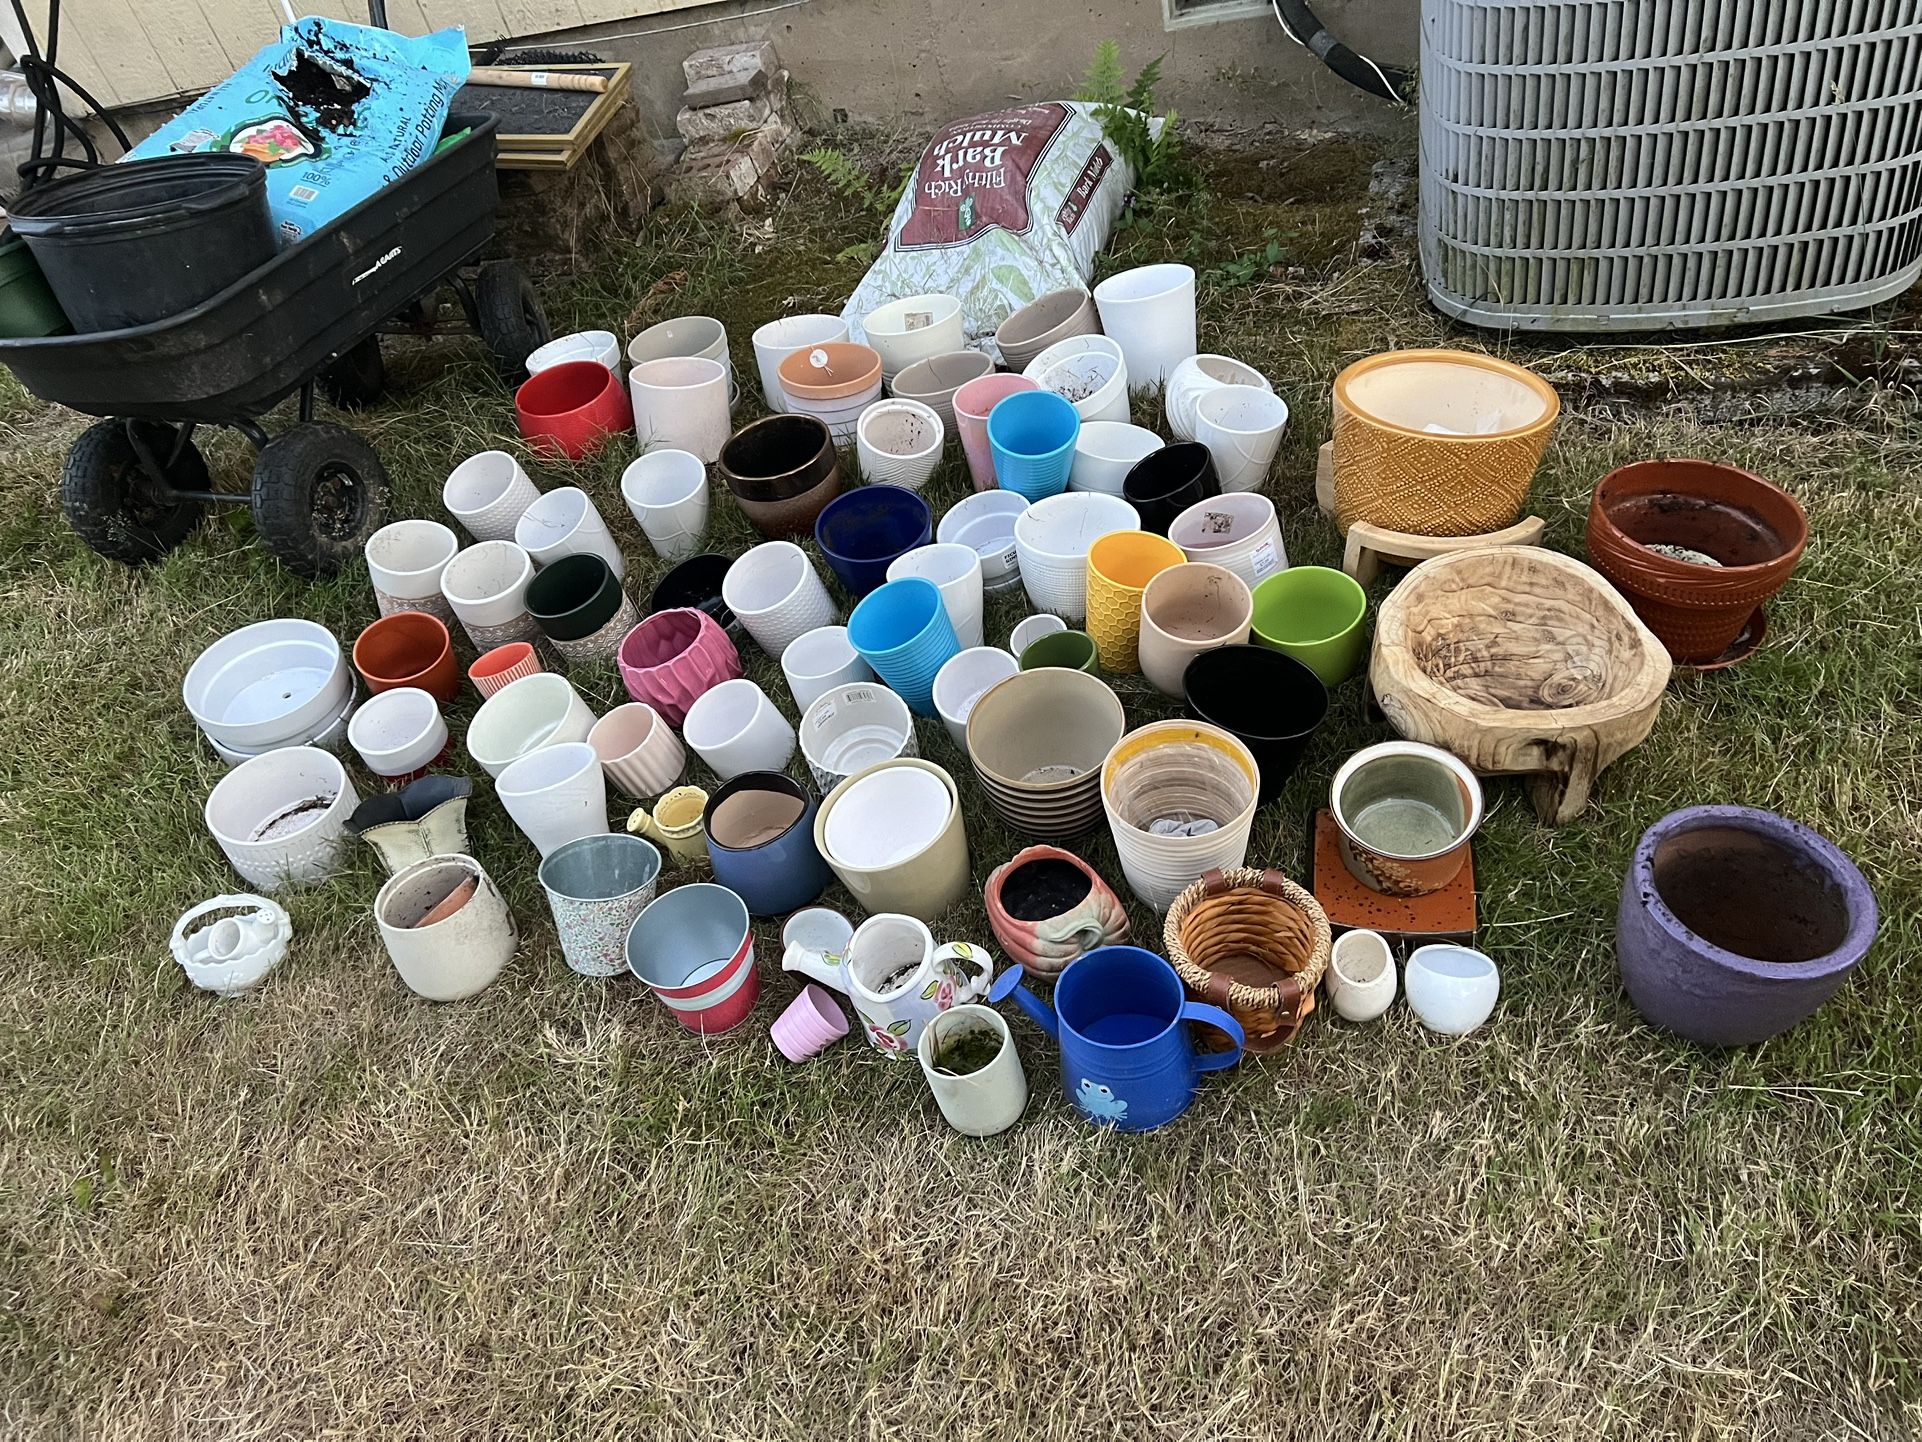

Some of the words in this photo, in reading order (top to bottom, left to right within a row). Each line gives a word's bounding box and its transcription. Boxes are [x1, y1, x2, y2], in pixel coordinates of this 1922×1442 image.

[392, 134, 424, 177] Outdoor
[415, 92, 445, 139] Potting
[932, 129, 1029, 156] Mulch
[933, 145, 1008, 178] Bark
[302, 171, 331, 186] 100%
[963, 166, 1006, 189] Filthy
[1076, 176, 1094, 199] Bark
[1004, 550, 1016, 560] FICU
